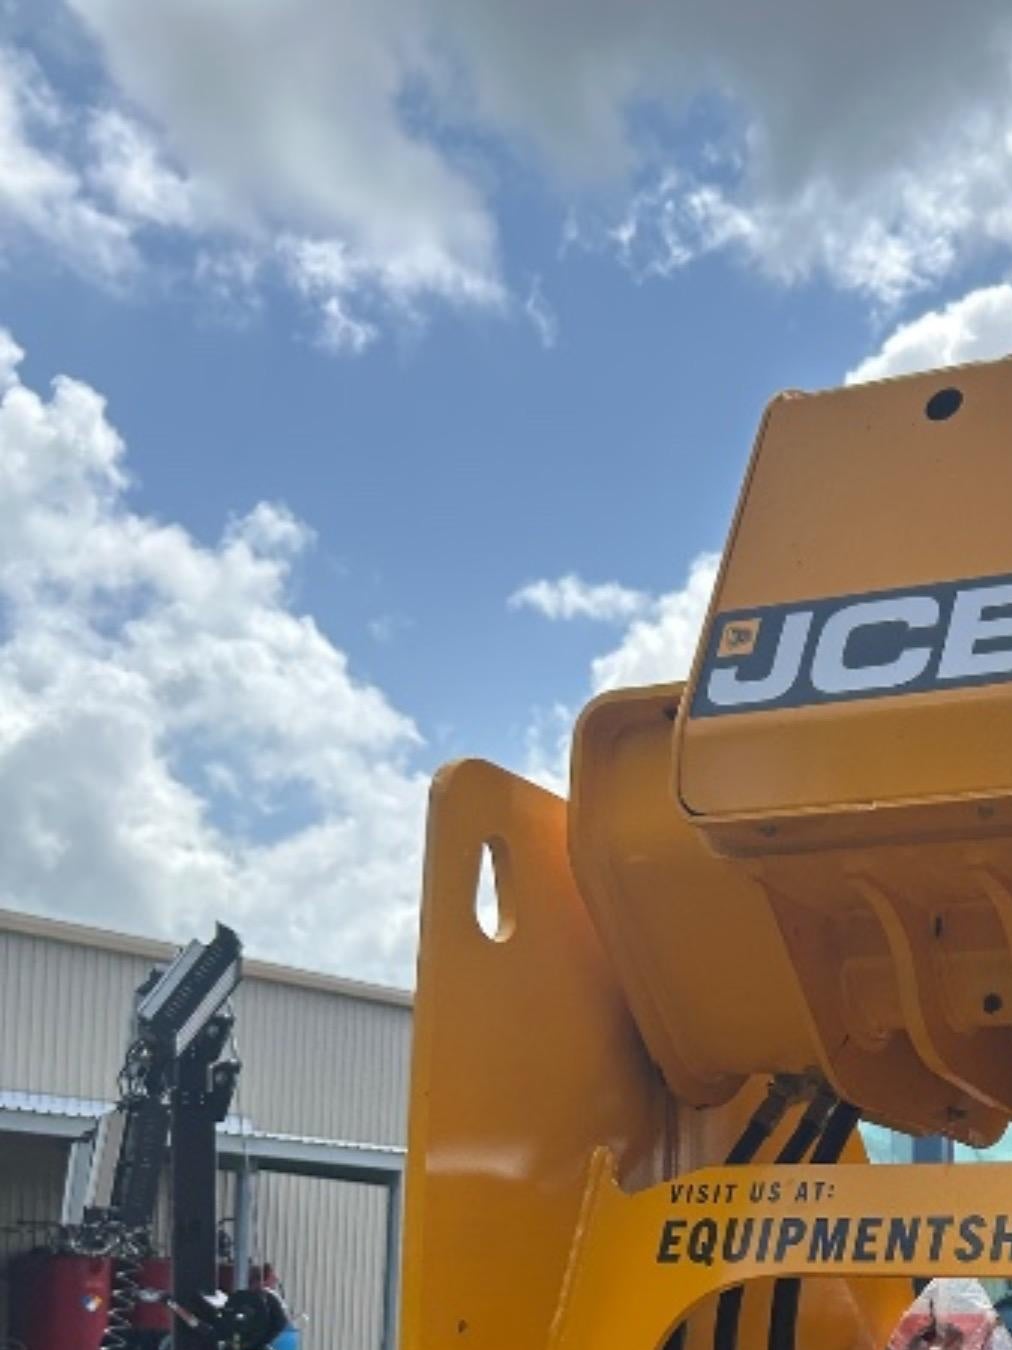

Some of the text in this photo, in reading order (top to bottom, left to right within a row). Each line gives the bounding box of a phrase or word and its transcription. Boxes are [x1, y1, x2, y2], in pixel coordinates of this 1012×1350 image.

[670, 1181, 835, 1204] VISIT US AT:
